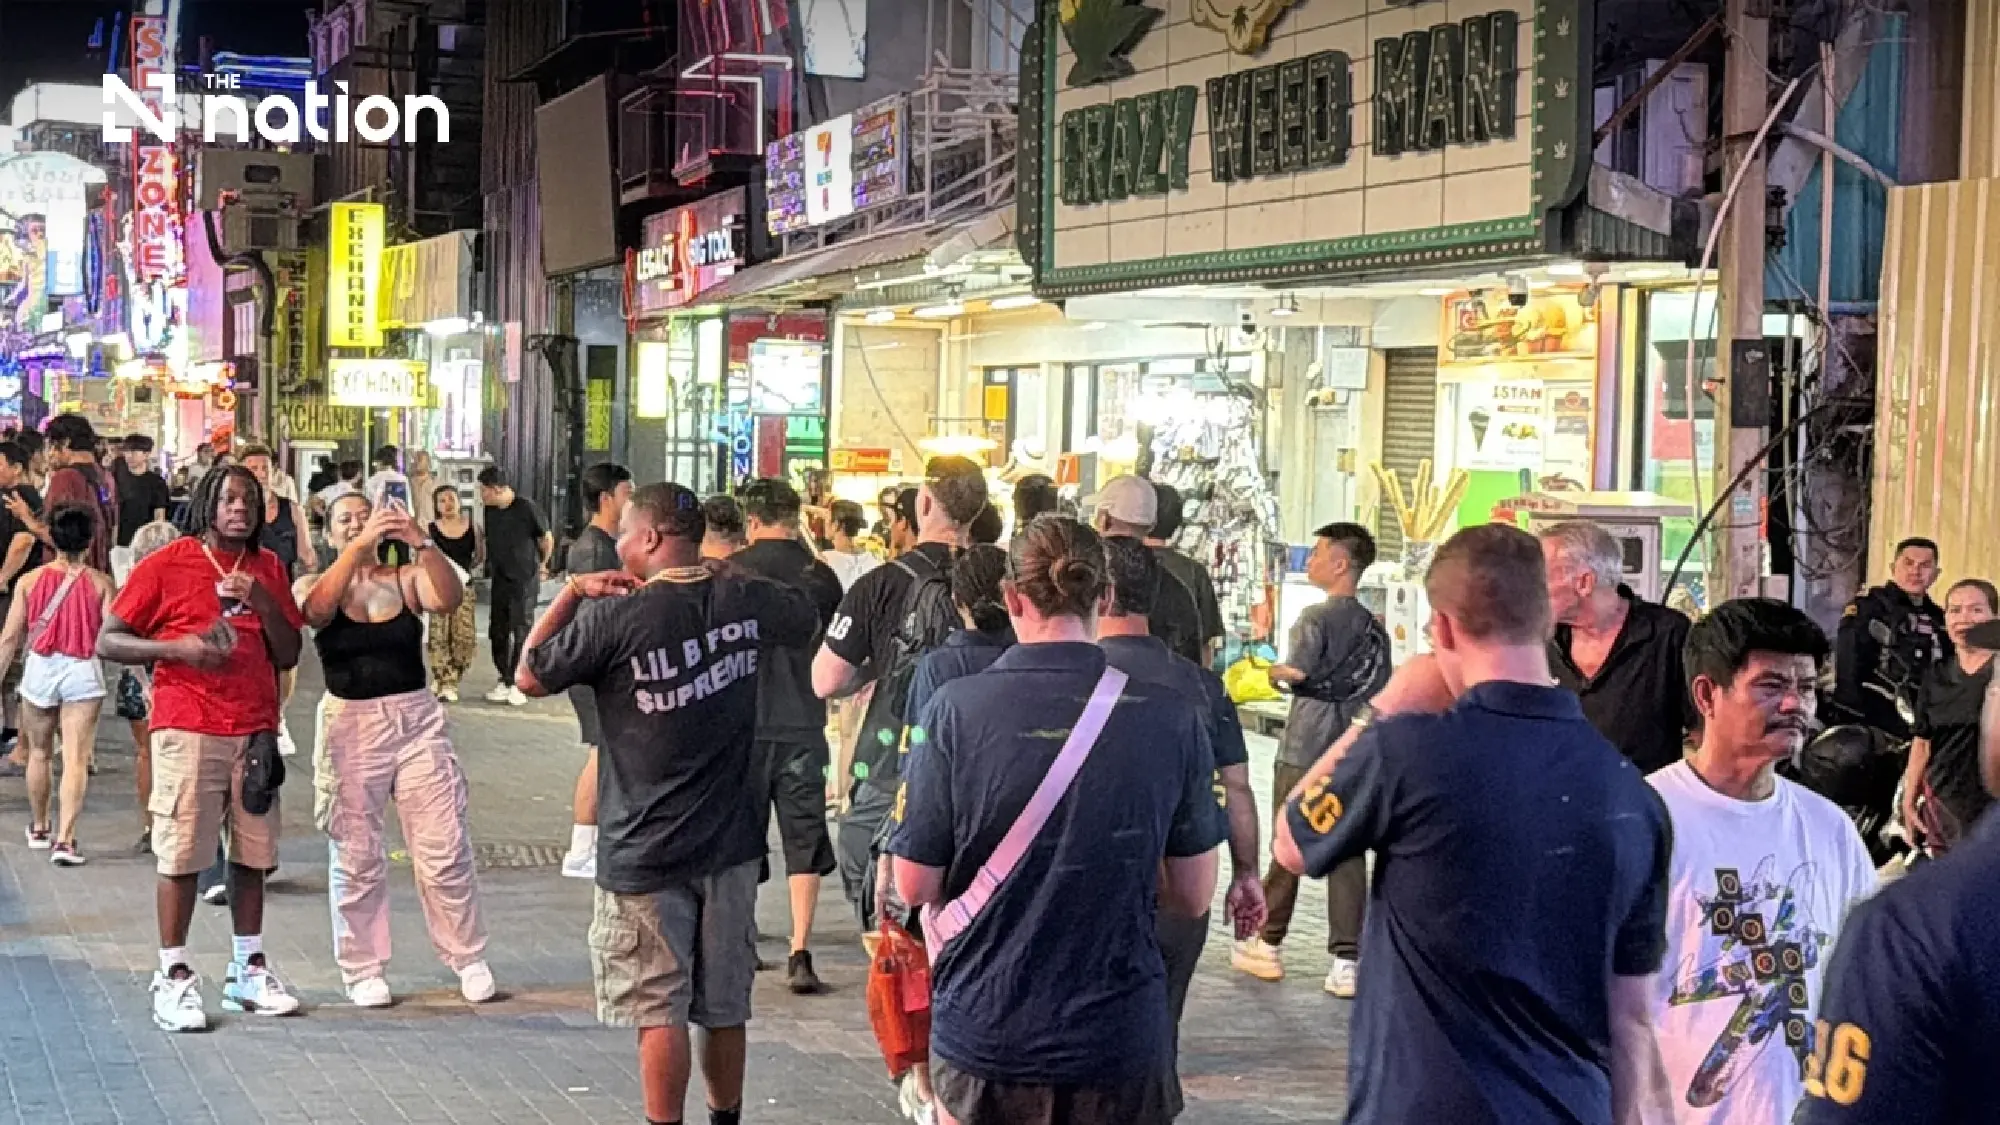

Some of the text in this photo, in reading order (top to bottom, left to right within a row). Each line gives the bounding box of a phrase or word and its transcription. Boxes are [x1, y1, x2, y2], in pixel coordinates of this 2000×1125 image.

[1061, 10, 1519, 205] CRAZY WEED MAN
[140, 147, 166, 280] ZONE
[347, 208, 365, 342] EXCHANGE
[331, 368, 426, 398] EXCHANGE
[631, 619, 760, 681] LIL B FOR
